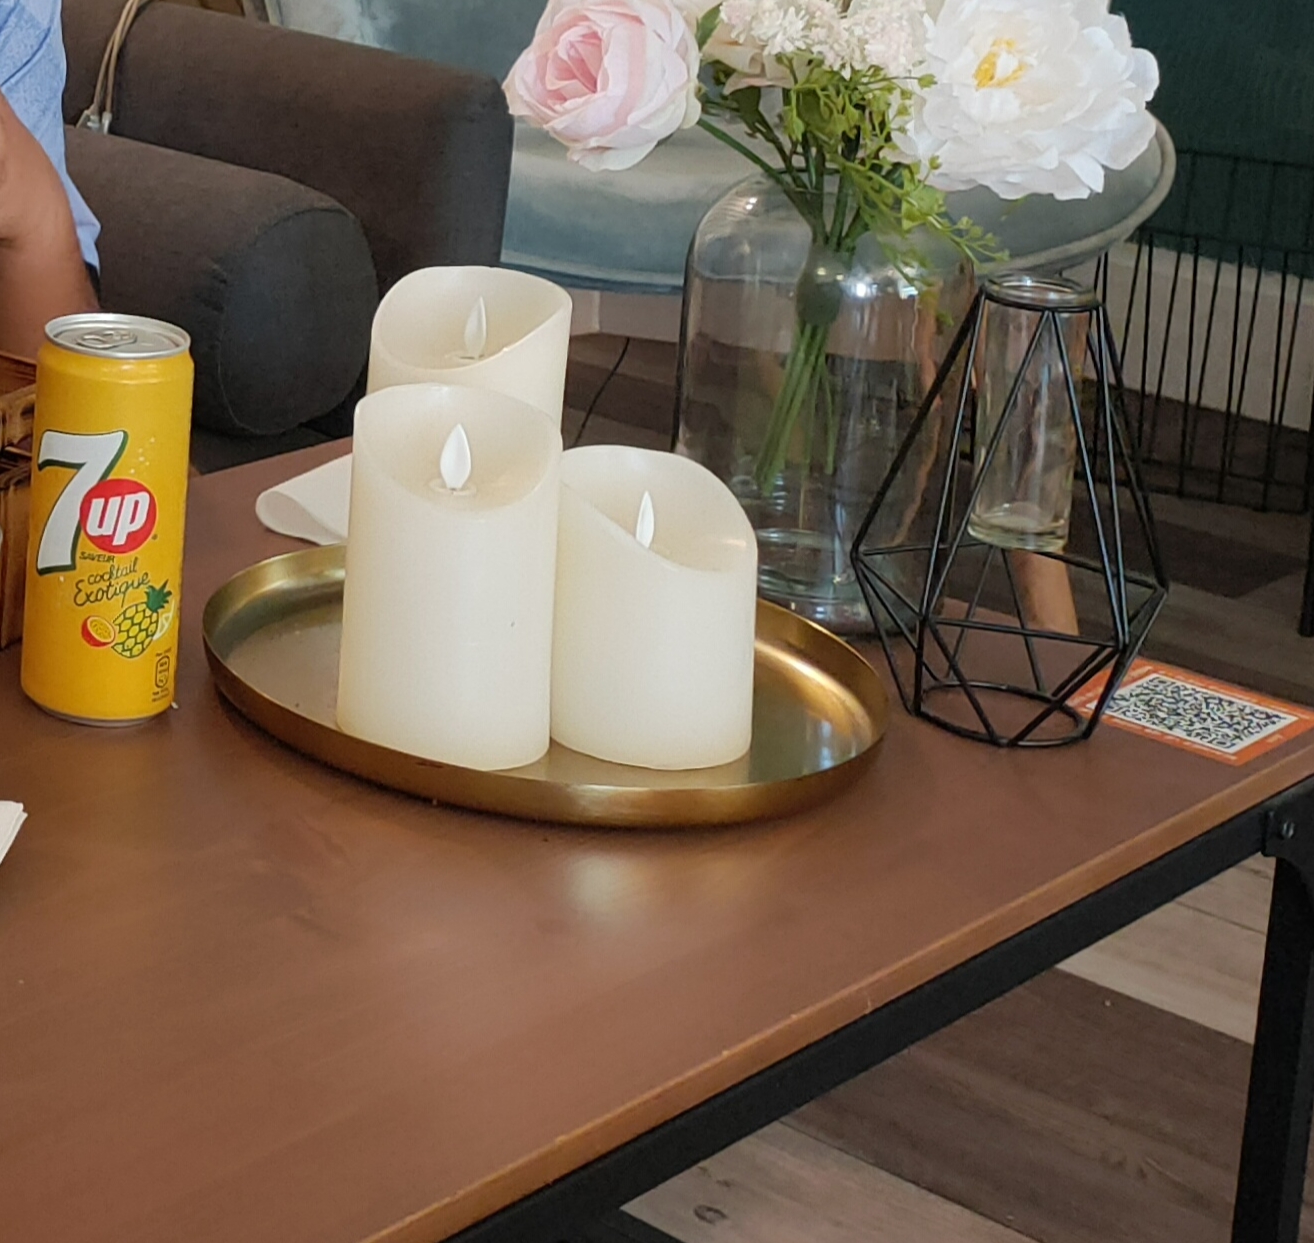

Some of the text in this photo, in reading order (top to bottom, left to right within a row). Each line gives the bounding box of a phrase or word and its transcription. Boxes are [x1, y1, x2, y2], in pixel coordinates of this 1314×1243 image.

[79, 551, 116, 564] SAVEUR
[87, 556, 139, 586] cocktail
[73, 571, 151, 609] Exotique
